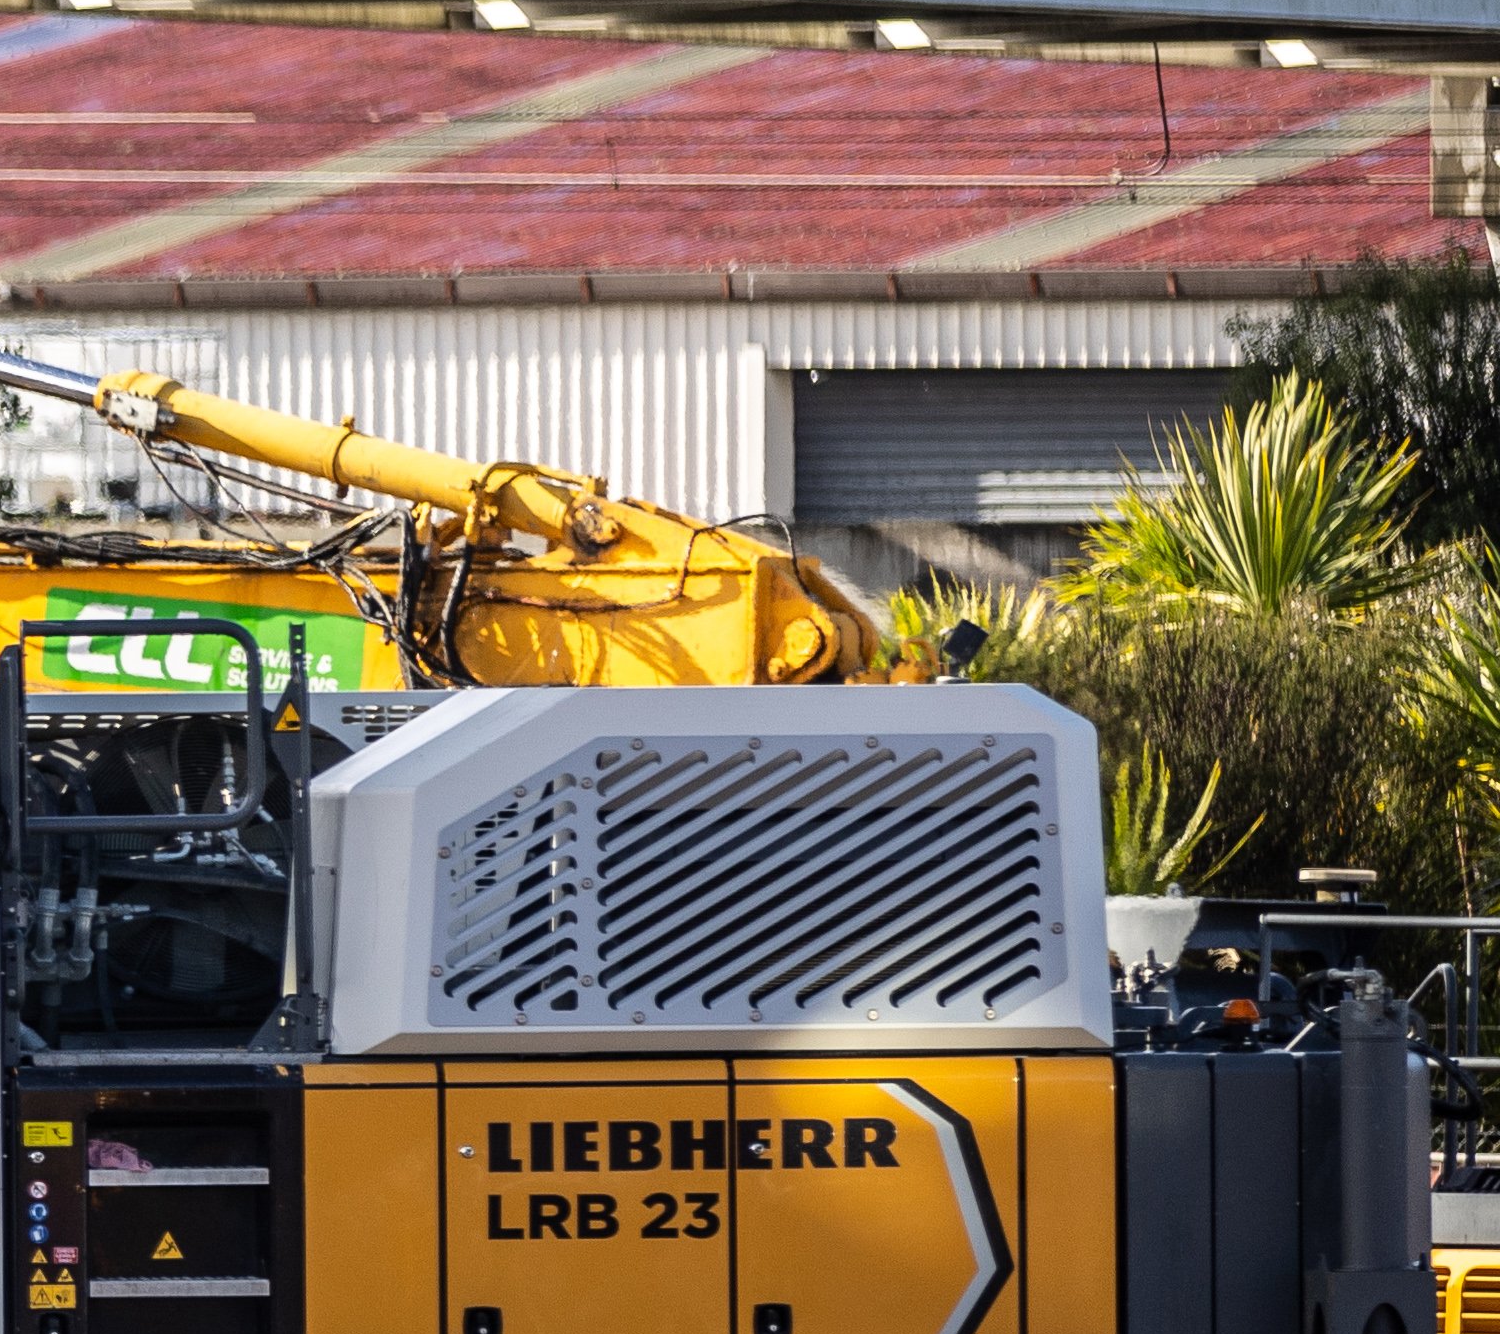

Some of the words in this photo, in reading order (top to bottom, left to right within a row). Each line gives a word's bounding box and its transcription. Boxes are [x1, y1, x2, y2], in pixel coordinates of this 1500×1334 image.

[67, 602, 213, 683] CLL
[316, 654, 332, 674] &
[487, 1118, 900, 1173] LIEBHERR
[487, 1193, 620, 1240] LRB
[640, 1192, 721, 1240] 23
